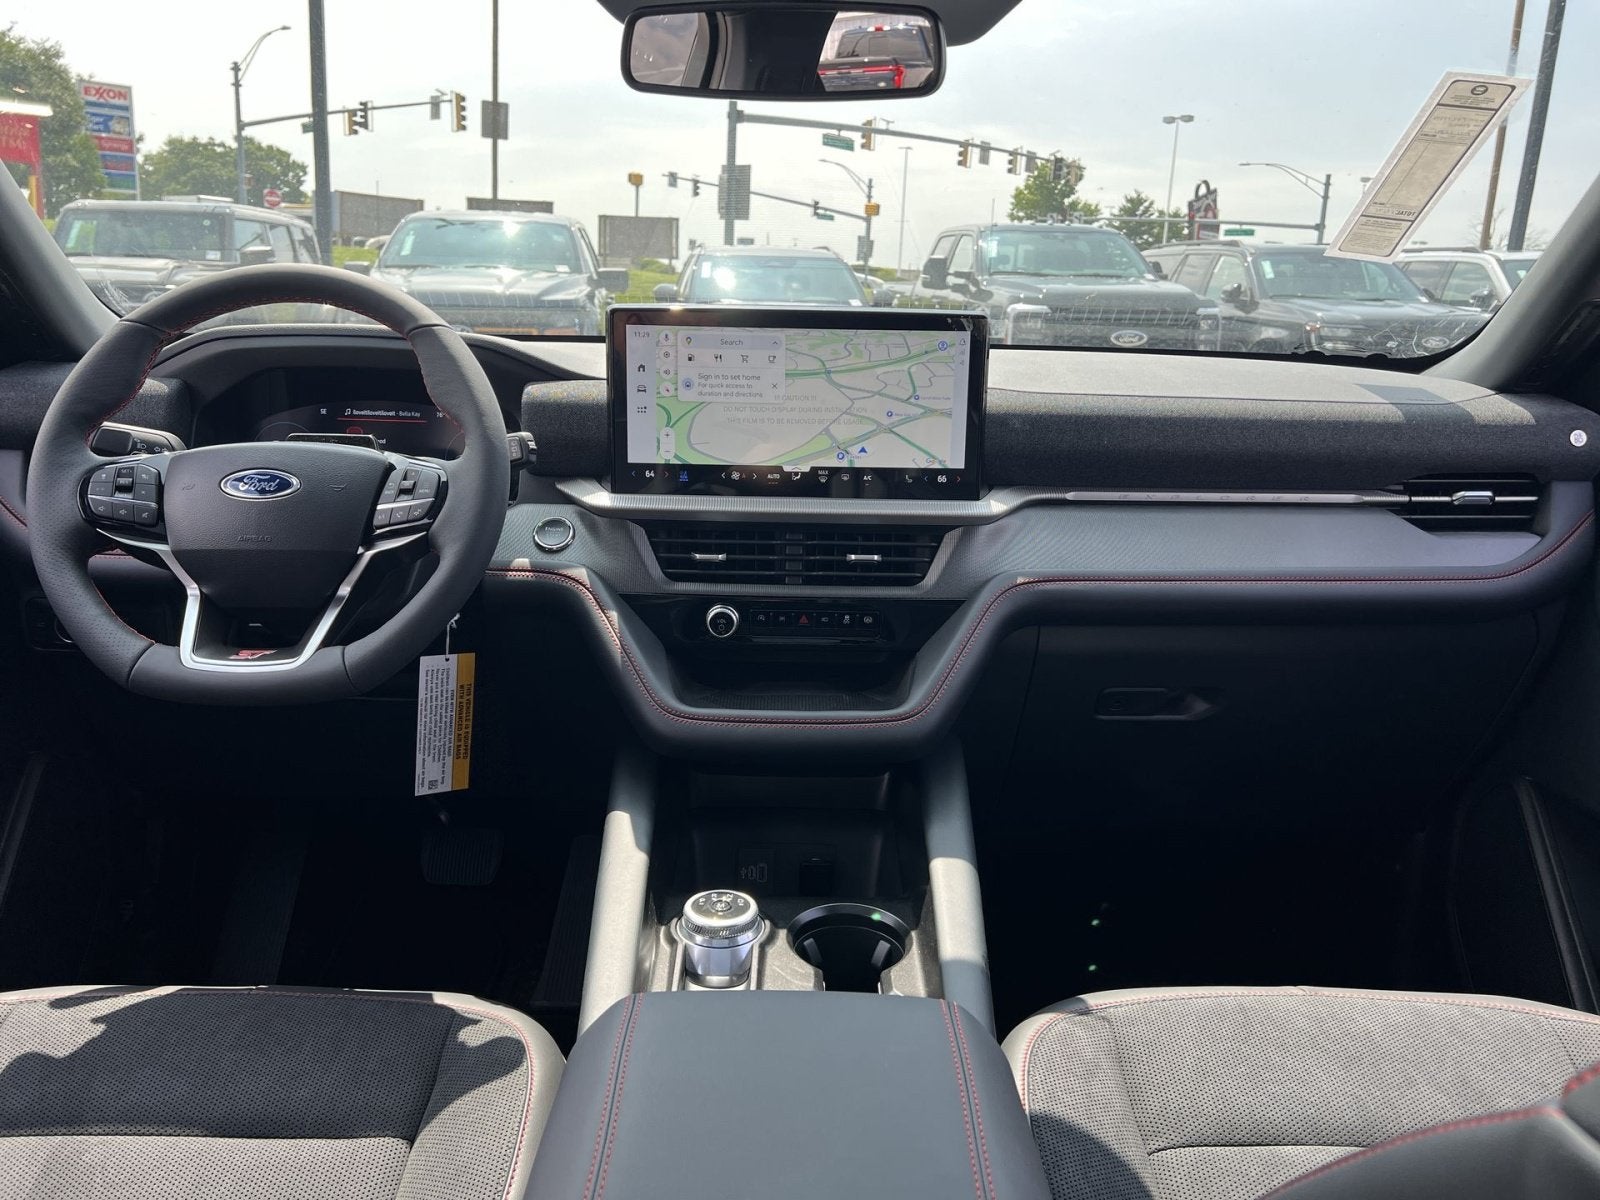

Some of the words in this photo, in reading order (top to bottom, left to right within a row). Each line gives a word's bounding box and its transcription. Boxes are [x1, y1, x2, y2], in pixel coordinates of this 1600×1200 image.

[83, 86, 128, 102] EXXON
[239, 474, 279, 491] Ford
[937, 475, 947, 483] 66
[237, 535, 273, 543] AIRBAG
